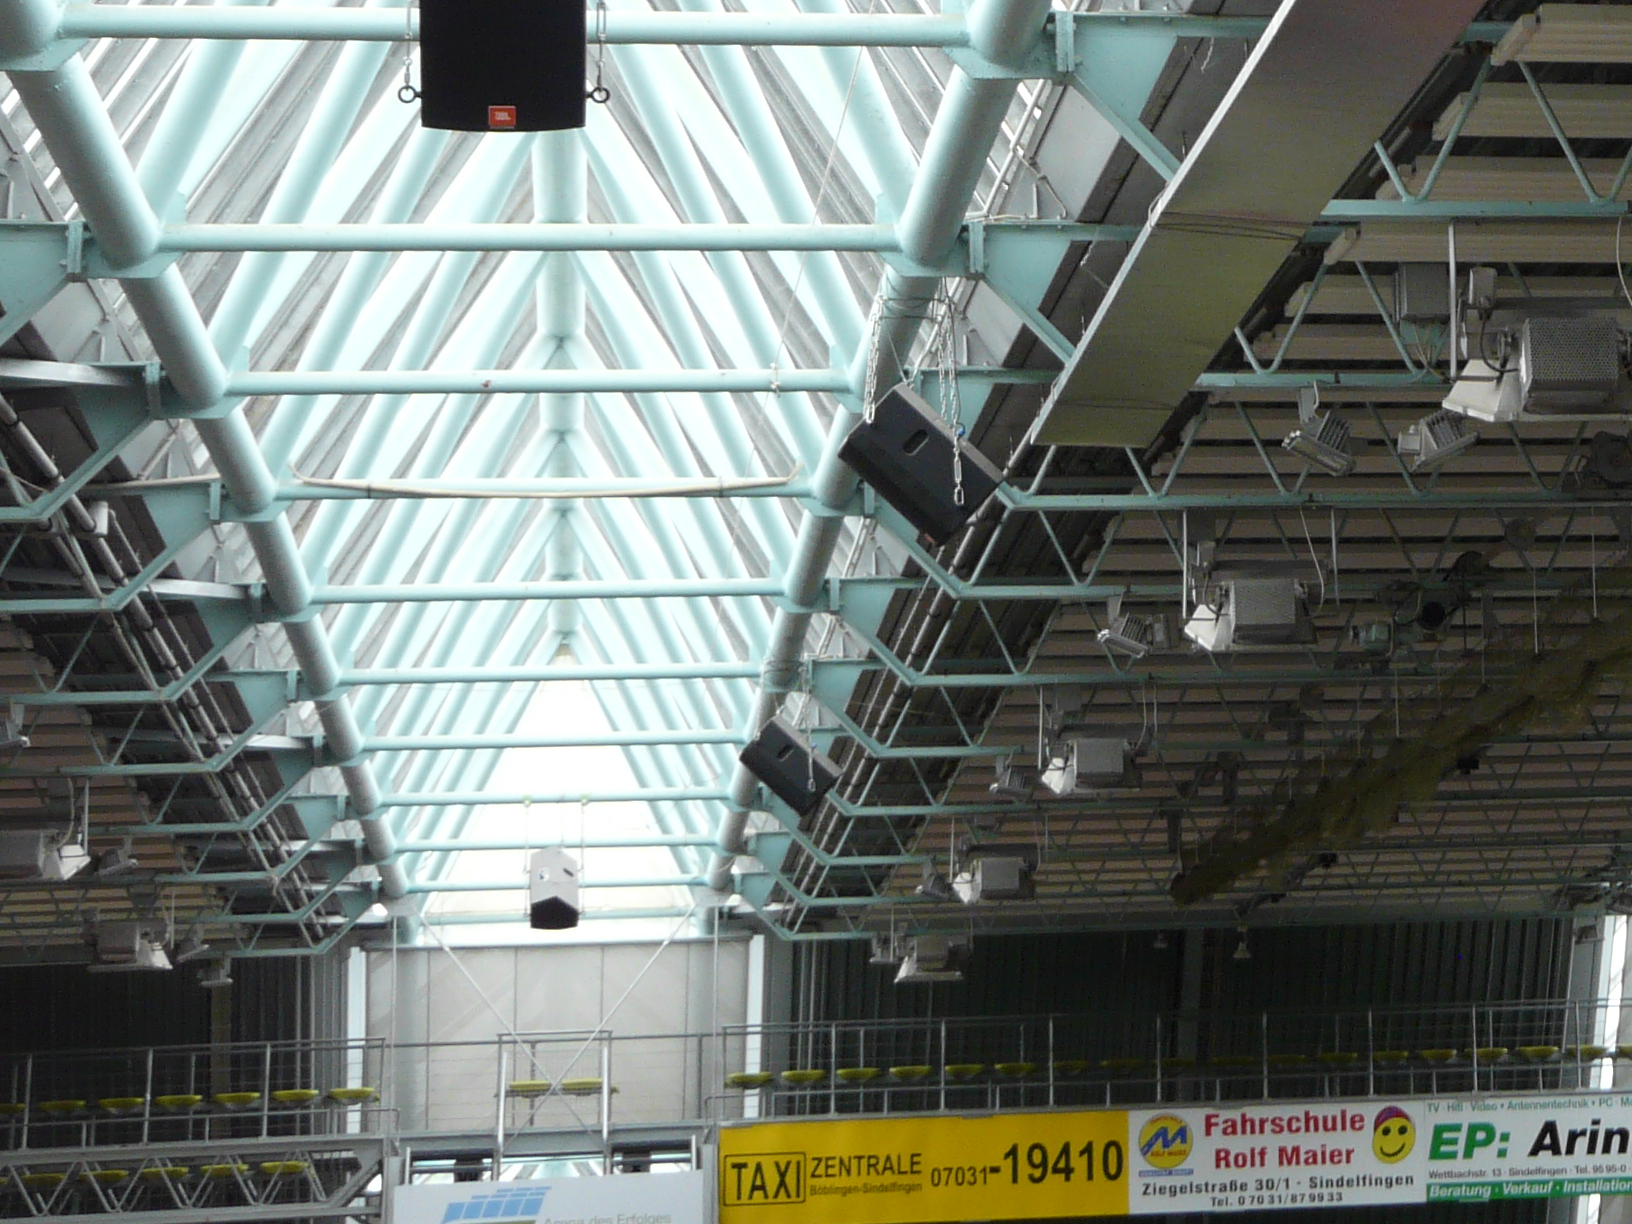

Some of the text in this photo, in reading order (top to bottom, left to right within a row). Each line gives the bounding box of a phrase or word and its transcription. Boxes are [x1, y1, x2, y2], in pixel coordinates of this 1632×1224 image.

[1427, 1102, 1440, 1113] TV
[1470, 1100, 1497, 1111] Video
[1507, 1097, 1589, 1112] Antennentechnik
[1599, 1097, 1613, 1108] PC
[1204, 1109, 1366, 1136] Fahrschule
[1428, 1121, 1511, 1160] EP:
[810, 1153, 922, 1178] ZENTRALE
[1214, 1144, 1355, 1169] Rolf Maier
[731, 1160, 801, 1201] TAXI
[1508, 1166, 1568, 1178] Sindelfingen
[1575, 1164, 1589, 1175] Tel.
[1142, 1174, 1414, 1197] Ziegelstraße 30/1 Sindelfingen
[1429, 1184, 1492, 1198] Beratung
[1502, 1180, 1554, 1195] Verkauf
[1210, 1195, 1233, 1207] Tel.
